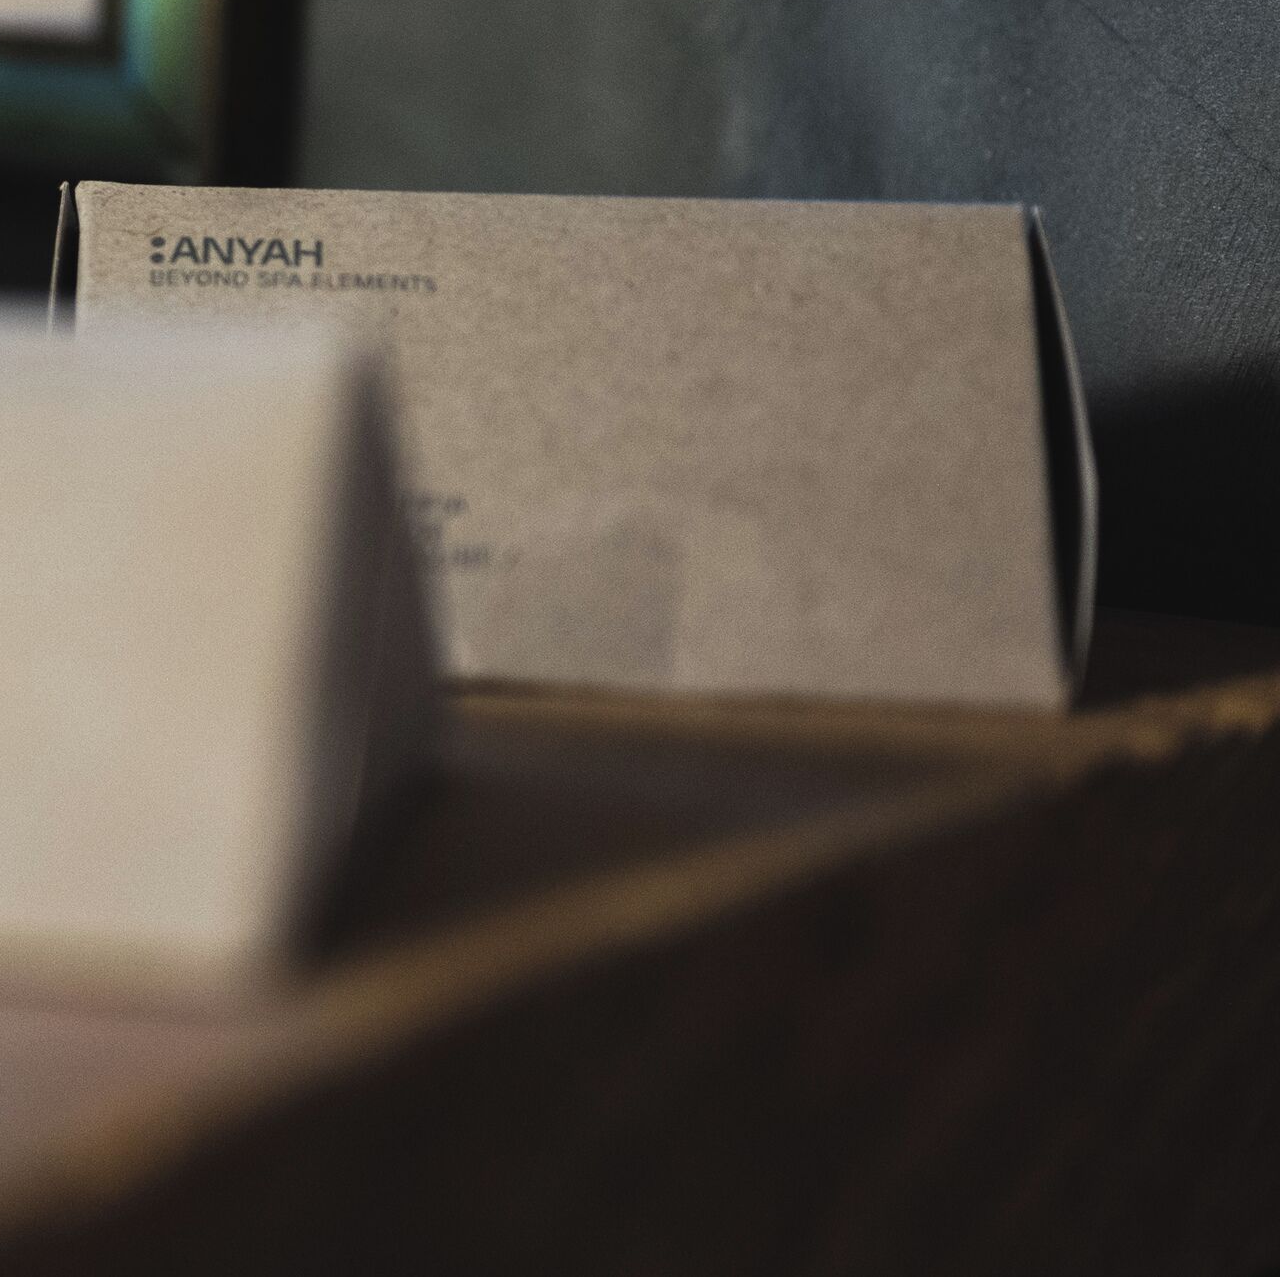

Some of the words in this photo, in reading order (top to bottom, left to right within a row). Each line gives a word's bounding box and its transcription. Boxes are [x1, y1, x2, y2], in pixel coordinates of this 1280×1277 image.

[150, 235, 324, 268] :ANYAH
[149, 269, 250, 289] BEYOND
[255, 270, 303, 290] SPA
[310, 272, 438, 294] ELEMENTS
